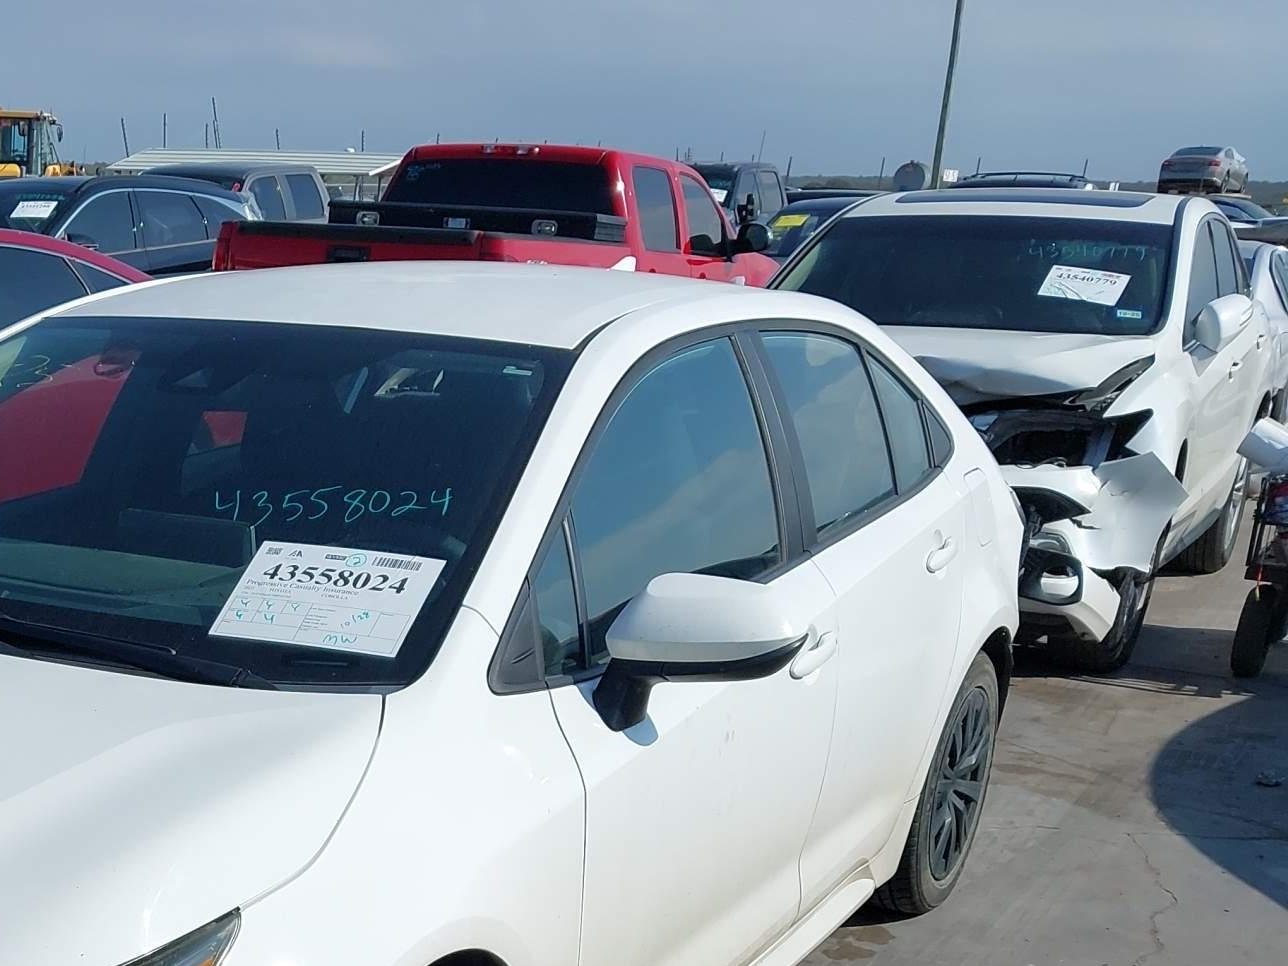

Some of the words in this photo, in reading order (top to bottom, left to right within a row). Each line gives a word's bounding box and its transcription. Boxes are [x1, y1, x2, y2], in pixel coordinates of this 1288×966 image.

[1055, 273, 1118, 286] 43540779
[215, 485, 454, 527] 43558024
[246, 578, 289, 588] Progressive
[289, 582, 322, 592] Casualty
[323, 586, 360, 596] Insurance
[263, 562, 410, 595] 43558024
